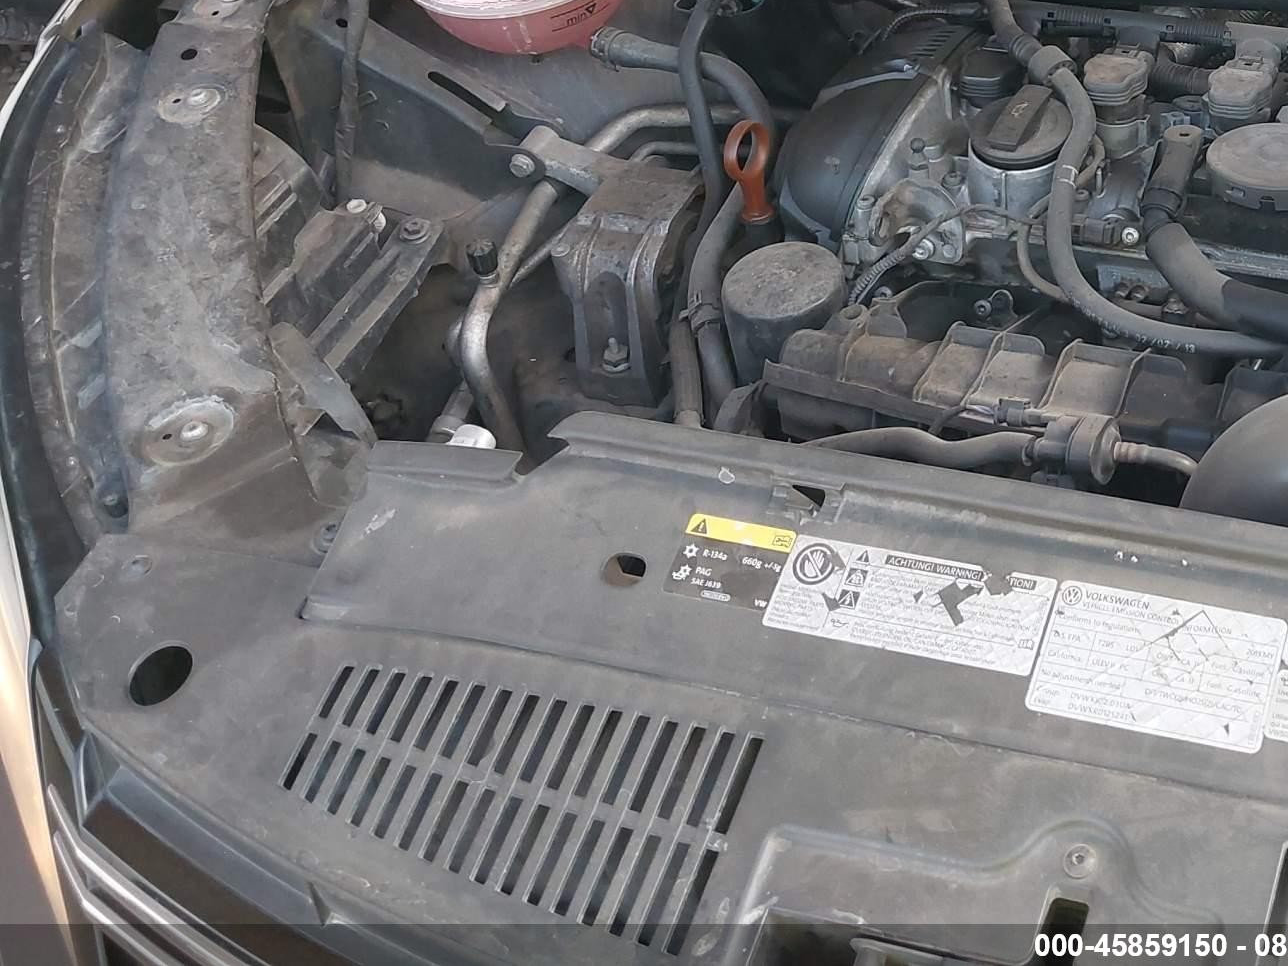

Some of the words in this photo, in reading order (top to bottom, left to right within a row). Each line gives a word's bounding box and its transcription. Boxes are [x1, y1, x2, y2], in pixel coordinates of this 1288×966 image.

[566, 12, 587, 27] min
[701, 548, 729, 561] R-134a
[739, 555, 762, 569] 660g
[694, 566, 712, 576] PAG
[887, 556, 935, 572] ACHTUNG!
[933, 564, 982, 580] WARNING!
[1008, 577, 1034, 589] TION!
[690, 577, 704, 586] SAE
[1084, 590, 1151, 610] VOLKSWAGEN
[1183, 620, 1233, 639] NFORMTION
